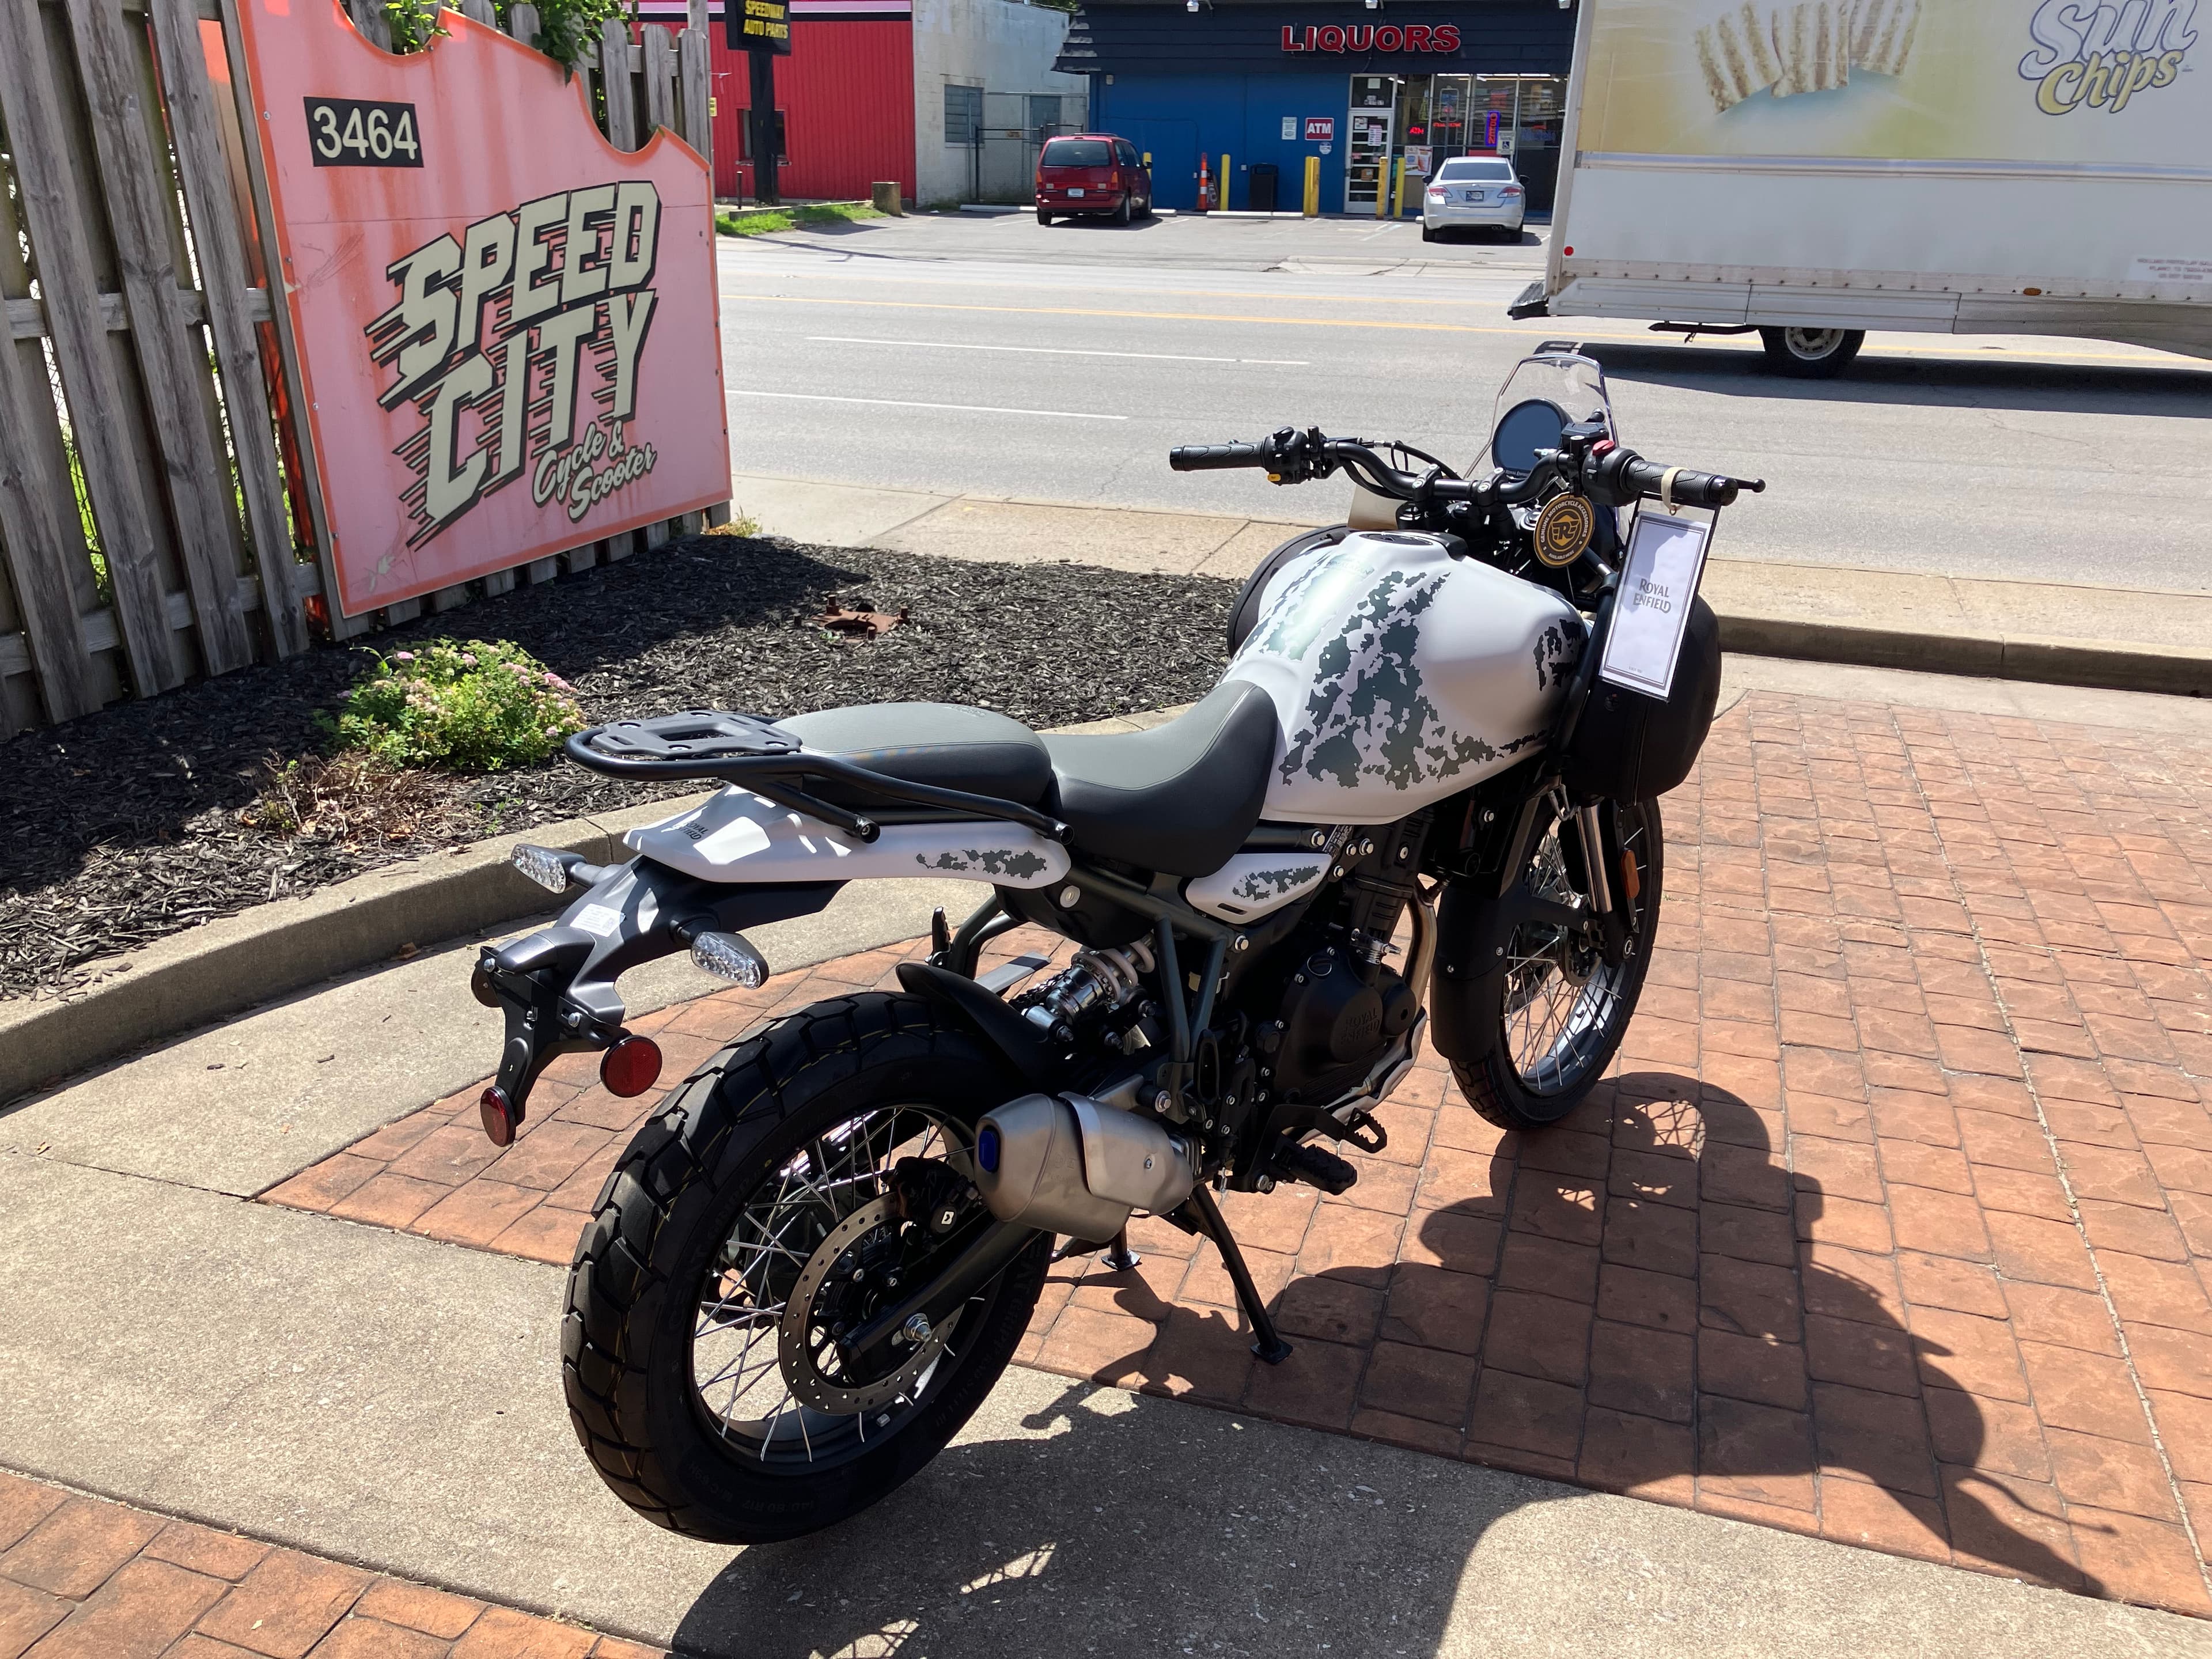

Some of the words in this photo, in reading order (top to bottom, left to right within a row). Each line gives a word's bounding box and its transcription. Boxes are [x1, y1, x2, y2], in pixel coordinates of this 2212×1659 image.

[743, 18, 765, 36] AUTO
[764, 22, 789, 39] PARTS
[1281, 25, 1461, 54] LIQUORS
[2035, 50, 2185, 116] Chips
[313, 105, 418, 160] 3464
[1306, 122, 1332, 134] ATM
[1487, 112, 1498, 145] OPEN
[368, 180, 662, 410] SPEED
[397, 288, 659, 544] CITY
[533, 421, 607, 506] Cycle
[608, 419, 625, 458] &
[568, 442, 658, 521] Scooter
[1540, 516, 1550, 543] GENUINE
[1547, 500, 1579, 519] MOTORCYCLE
[1578, 503, 1589, 537] ACCESSORIES
[1632, 592, 1672, 614] ENFIELD
[1638, 578, 1670, 598] ROYAL
